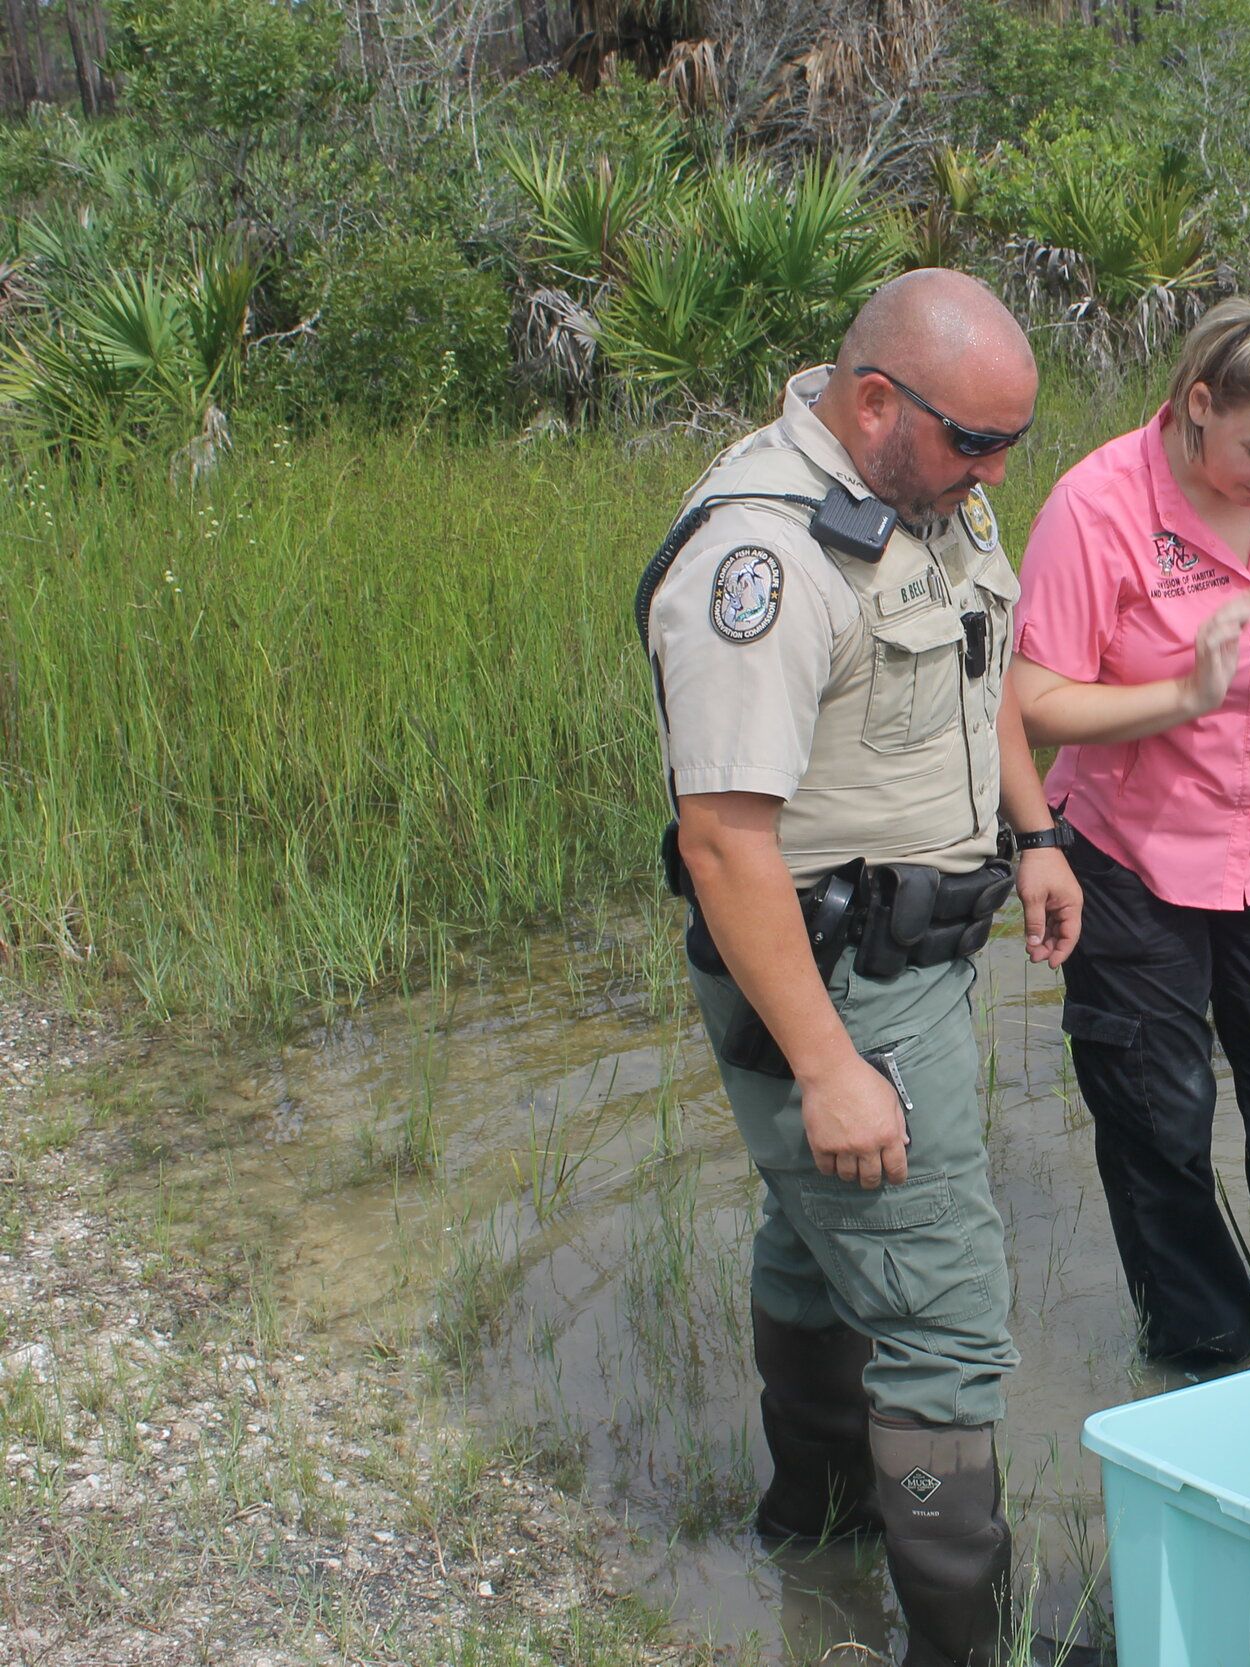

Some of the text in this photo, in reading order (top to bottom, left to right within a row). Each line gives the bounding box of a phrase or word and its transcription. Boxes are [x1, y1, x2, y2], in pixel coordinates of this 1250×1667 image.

[717, 556, 736, 586] FLORIDA
[735, 548, 751, 559] FISH
[751, 549, 768, 560] AND
[1182, 575, 1190, 585] OF
[1192, 568, 1217, 582] HABITAT
[908, 579, 926, 599] BELL
[1150, 589, 1162, 598] AND
[1187, 575, 1230, 594] CONSERVATION
[744, 601, 776, 638] COMMISSION
[907, 1478, 935, 1489] MUCK
